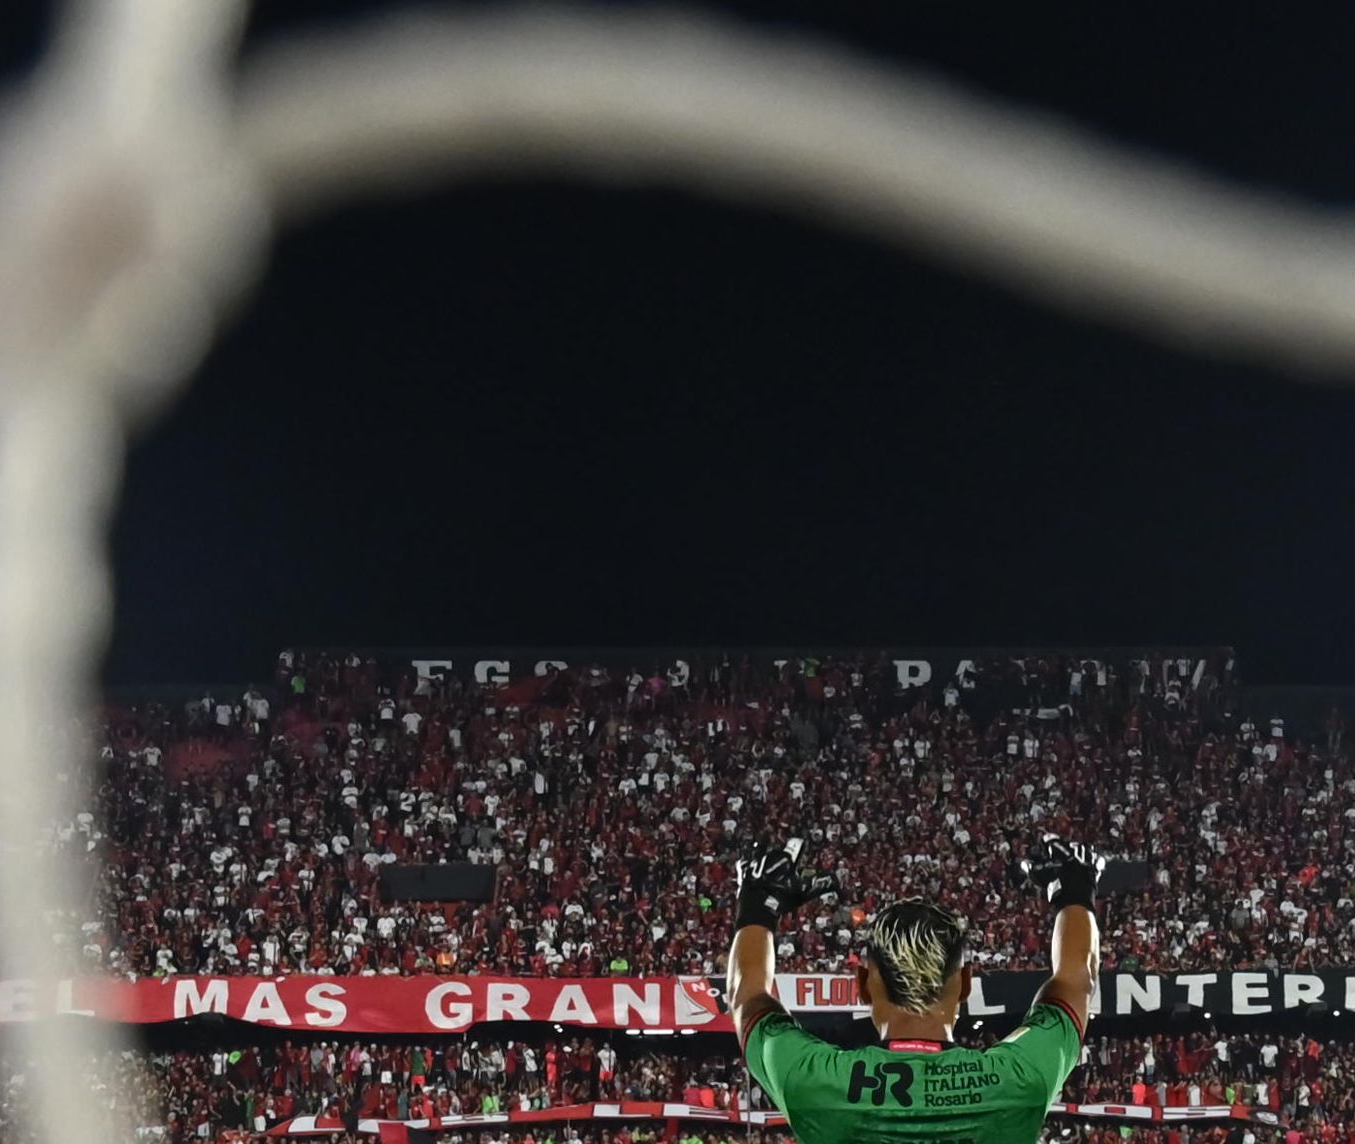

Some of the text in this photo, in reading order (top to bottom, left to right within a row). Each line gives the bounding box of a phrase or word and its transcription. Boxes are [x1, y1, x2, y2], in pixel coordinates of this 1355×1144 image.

[847, 1059, 982, 1107] HR Hospital
[924, 1073, 1000, 1092] ITALIANO
[924, 1090, 982, 1107] Rosario
